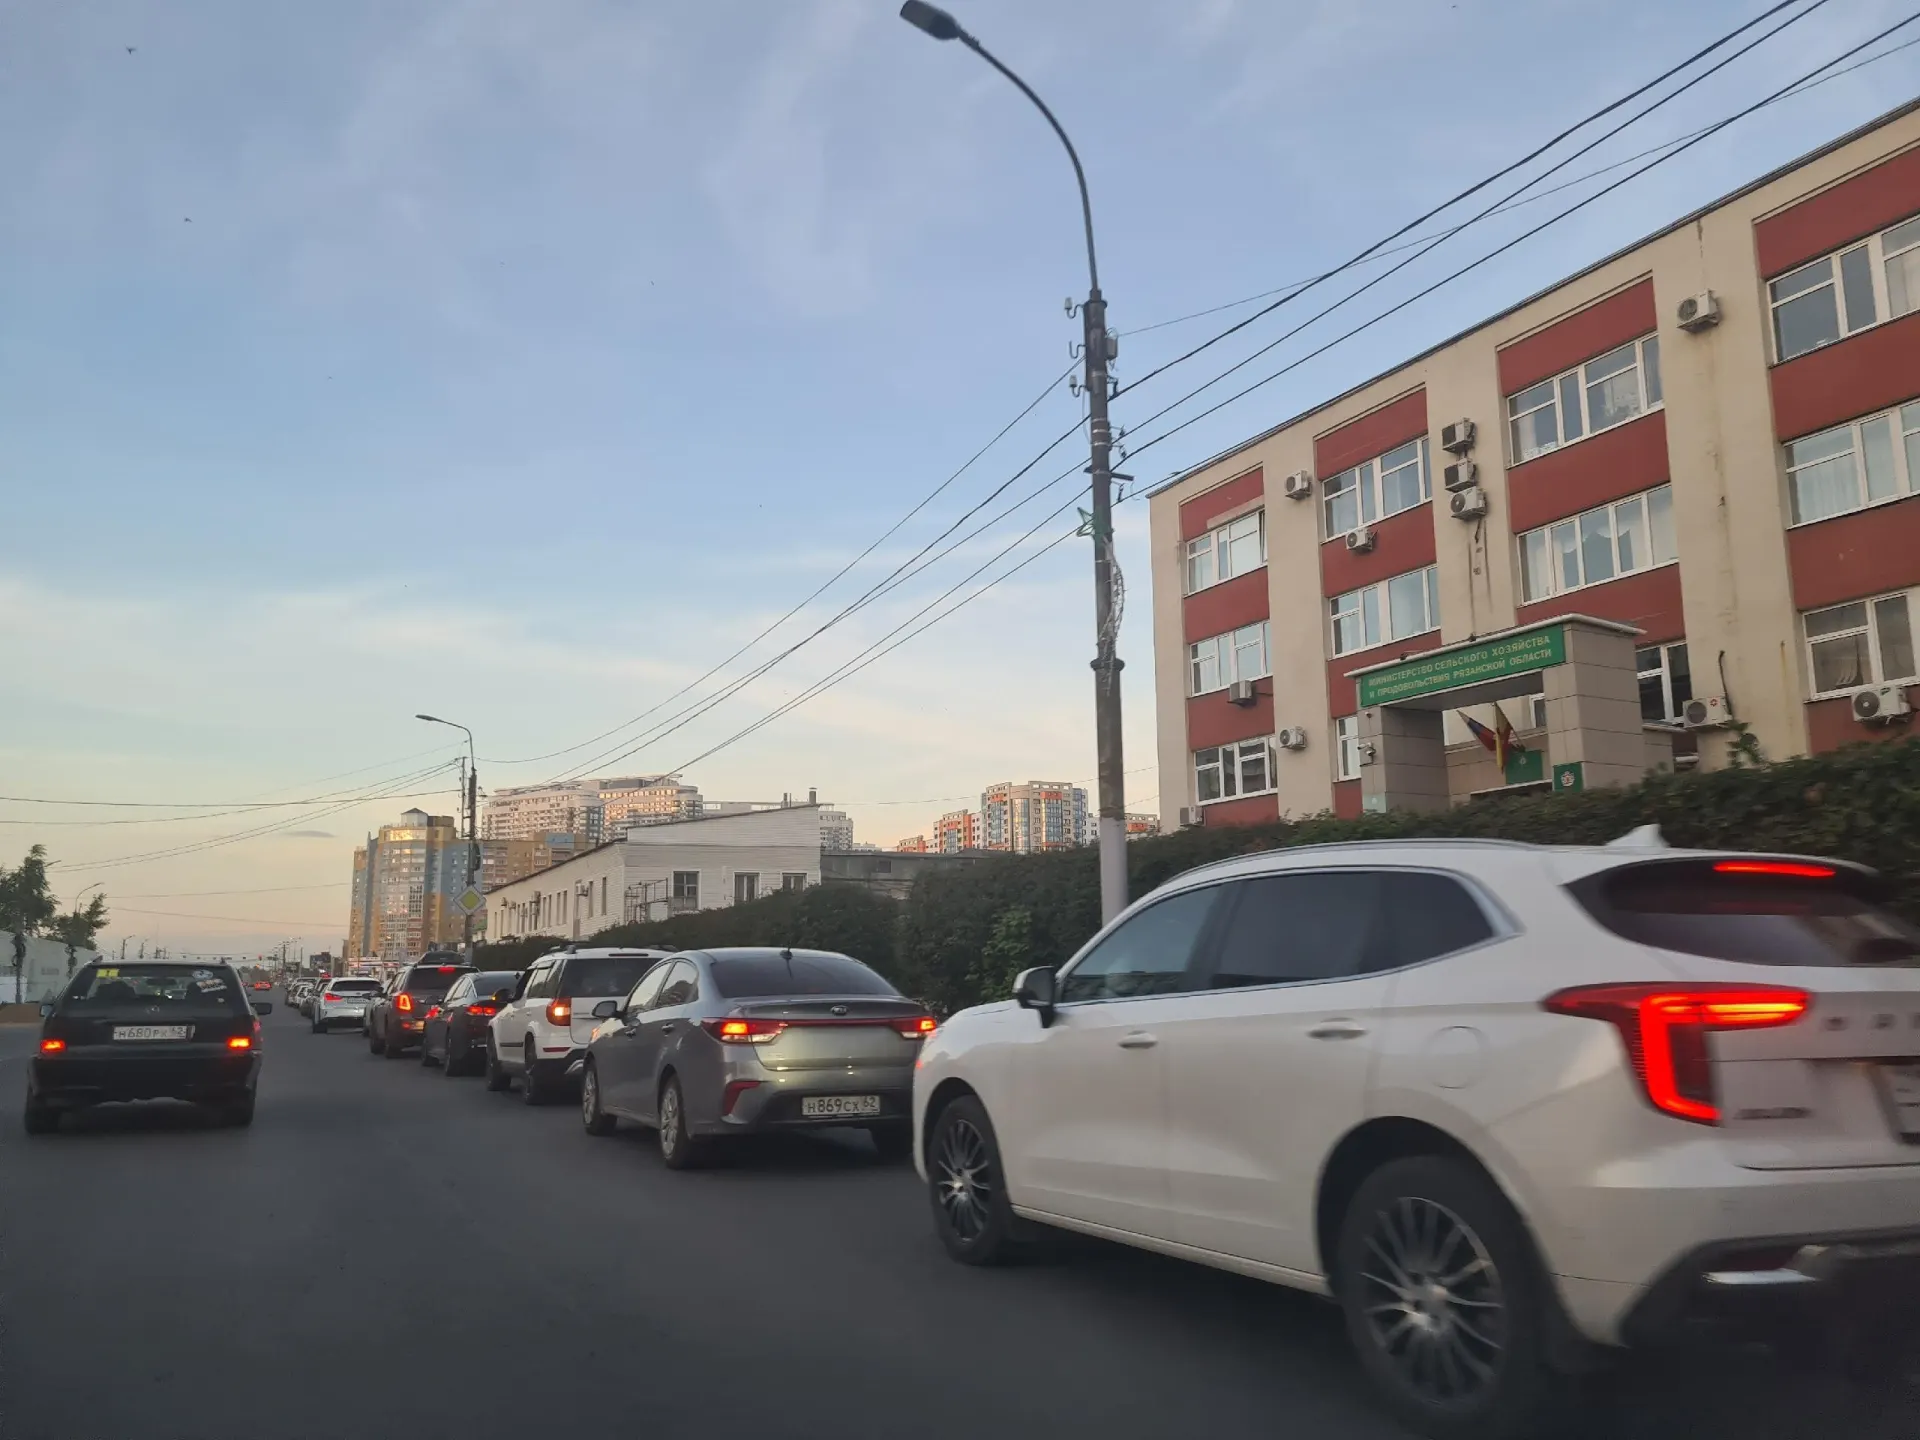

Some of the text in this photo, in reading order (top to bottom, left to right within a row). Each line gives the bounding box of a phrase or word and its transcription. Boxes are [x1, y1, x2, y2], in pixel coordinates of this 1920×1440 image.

[1368, 635, 1550, 687] МИНИСТЕРСТВО СЕЛЬСКОГО ХОЗЯЙСТВА
[1377, 674, 1450, 696] ПРОДОВОЛЬСТВИЯ
[1453, 657, 1506, 679] РЯЗАНСКОЙ
[1509, 648, 1552, 666] ОБЛАСТИ
